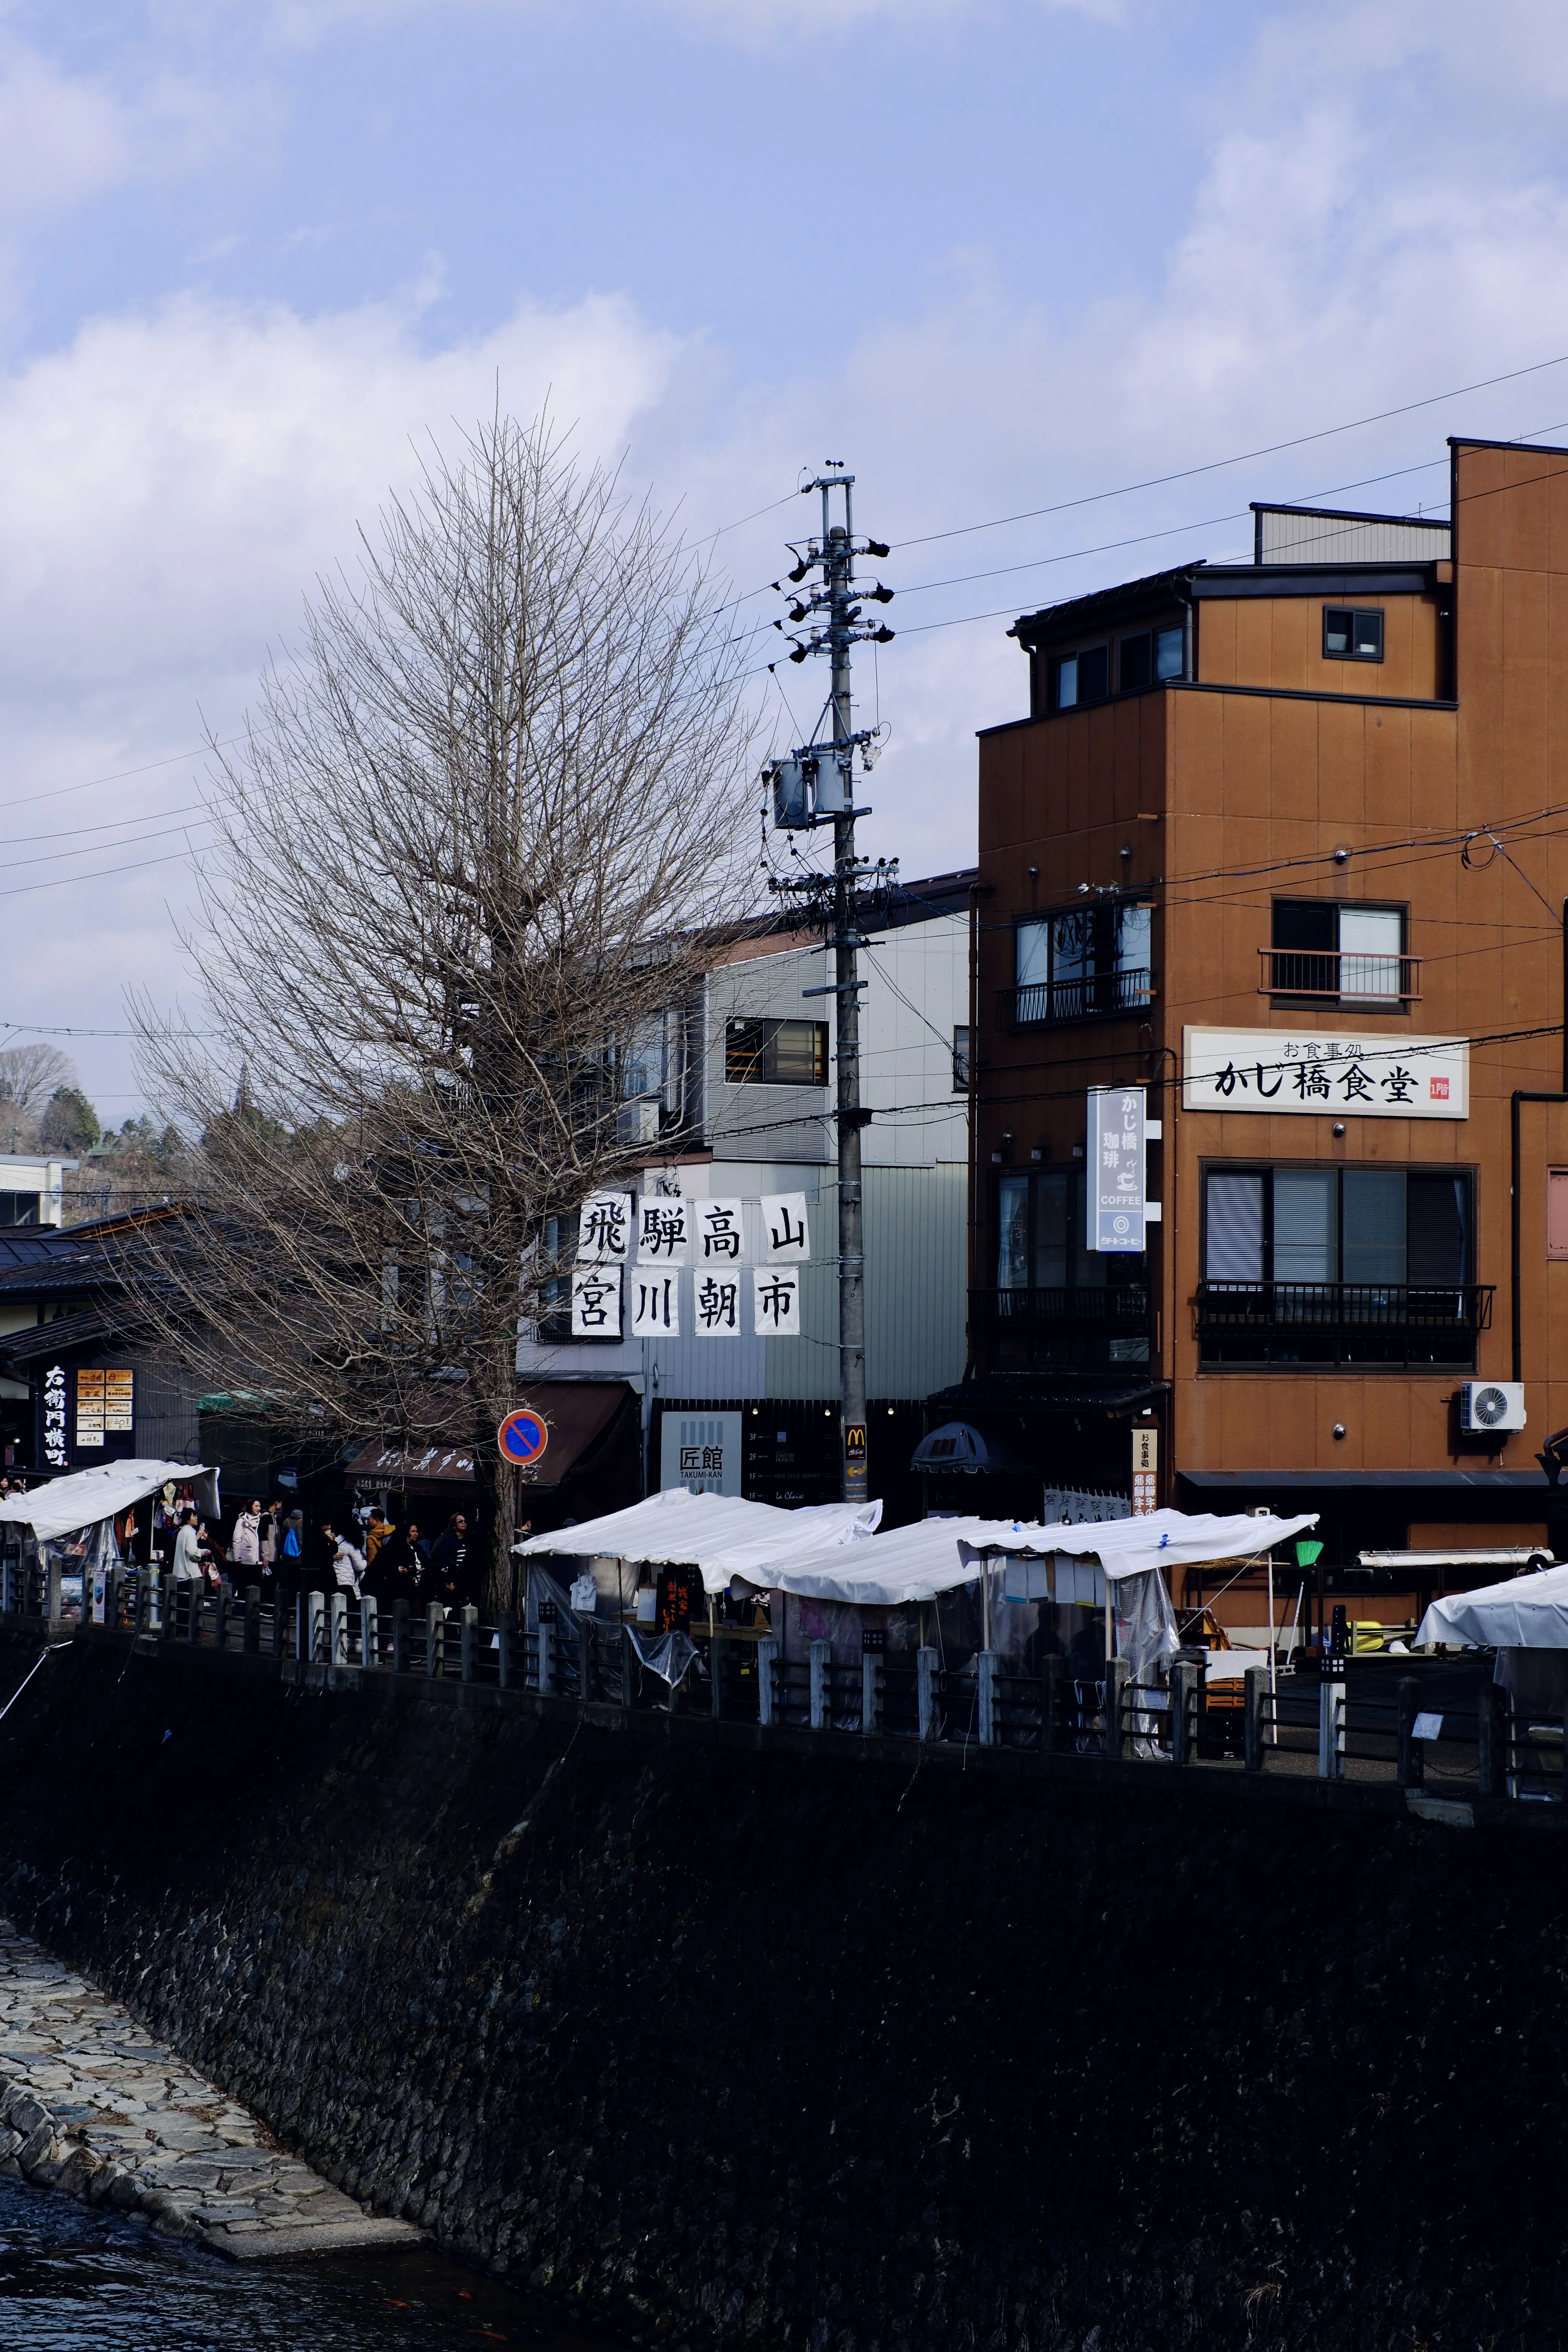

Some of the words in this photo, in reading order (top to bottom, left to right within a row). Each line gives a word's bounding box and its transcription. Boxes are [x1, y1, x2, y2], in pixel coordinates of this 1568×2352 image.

[1284, 1042, 1365, 1060] お食事処
[1215, 1061, 1419, 1103] かじ橋食堂
[1430, 1084, 1449, 1096] 1階
[1121, 1096, 1137, 1150] かじ橋
[1103, 1132, 1119, 1168] 珈琲
[1101, 1196, 1141, 1205] COFFEE
[582, 1202, 804, 1258] 飛騨高山
[576, 1276, 796, 1328] 宮川朝市
[680, 1446, 723, 1471] 匠館
